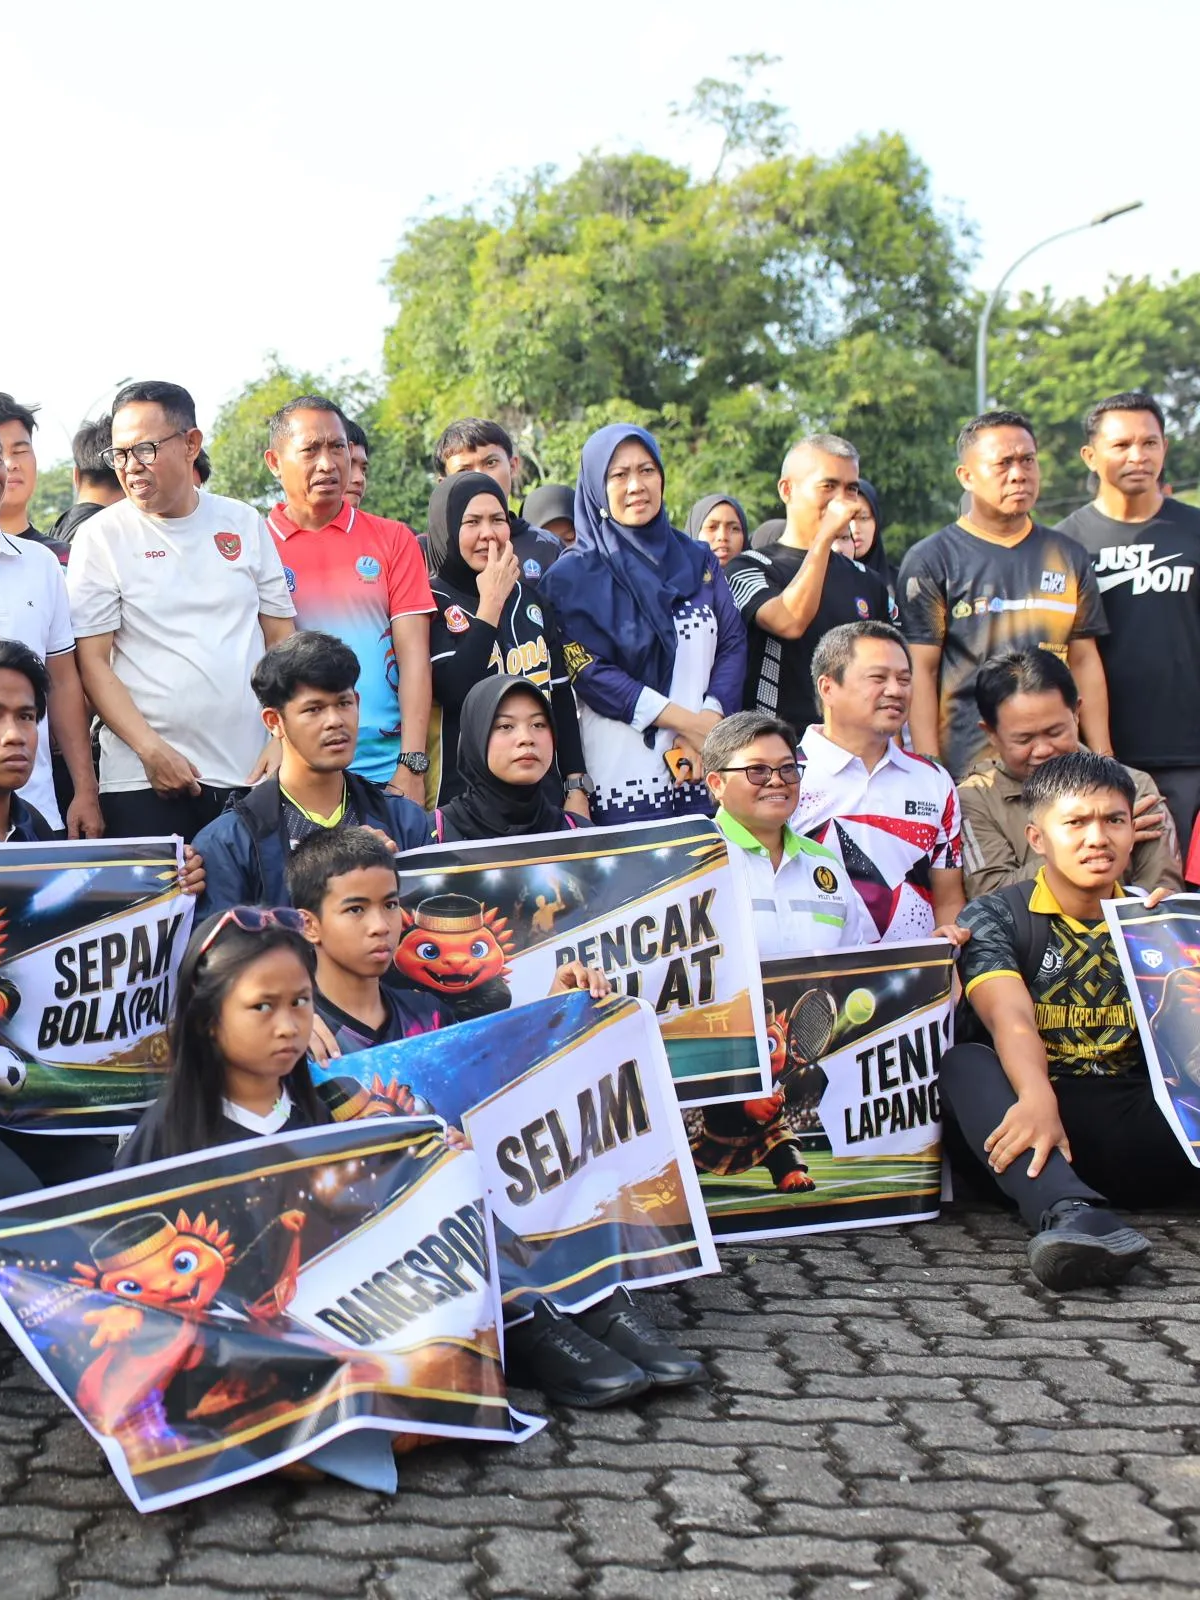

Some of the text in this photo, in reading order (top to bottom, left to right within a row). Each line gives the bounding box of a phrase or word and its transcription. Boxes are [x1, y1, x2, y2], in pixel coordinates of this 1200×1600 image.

[1041, 581, 1065, 592] BIKE
[1042, 571, 1065, 582] FUN
[1095, 544, 1155, 572] JUST
[54, 912, 184, 1000] SEPAK
[555, 887, 718, 974] PENCAK
[496, 1059, 651, 1207] SELAM
